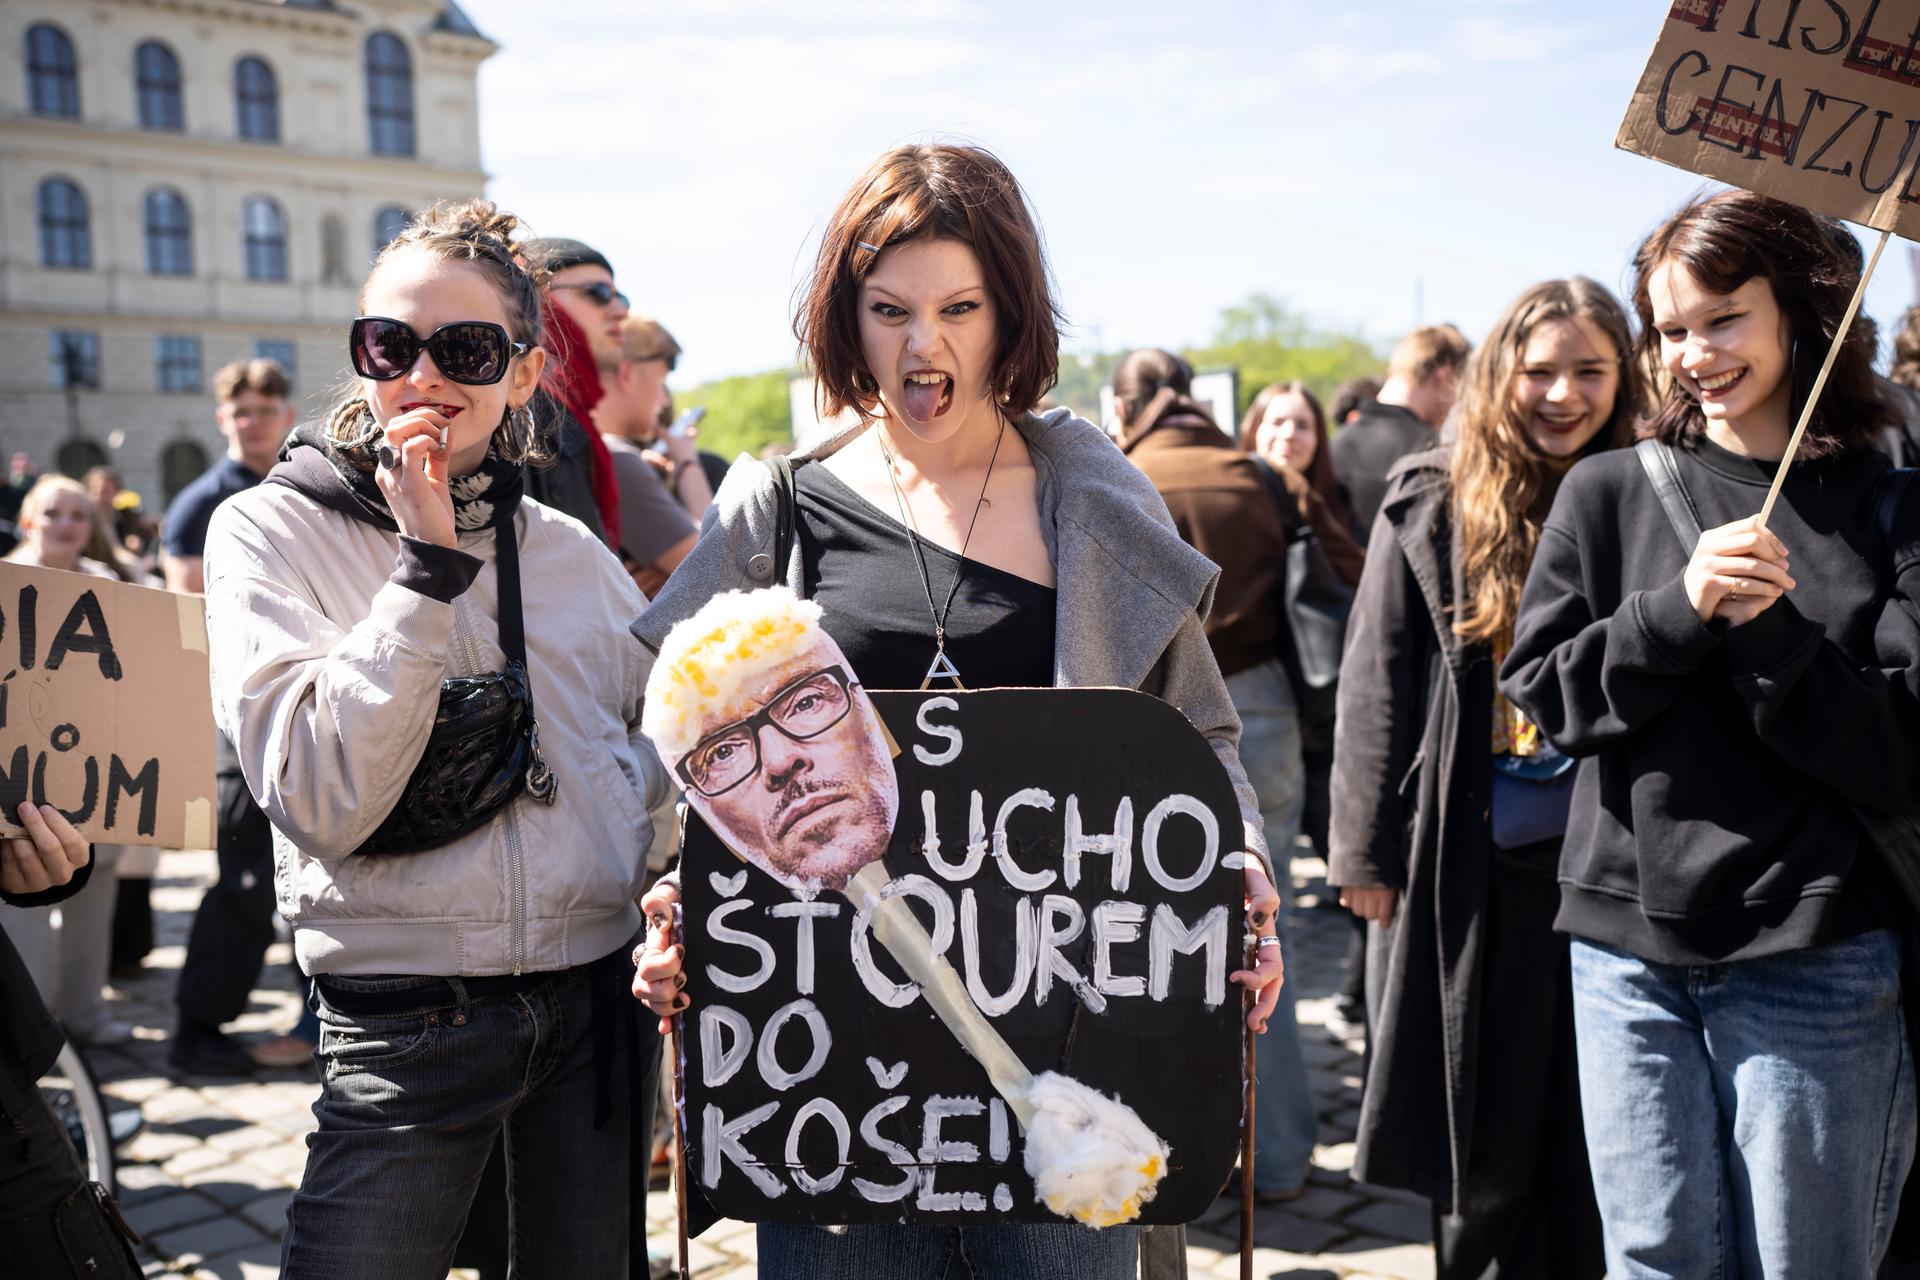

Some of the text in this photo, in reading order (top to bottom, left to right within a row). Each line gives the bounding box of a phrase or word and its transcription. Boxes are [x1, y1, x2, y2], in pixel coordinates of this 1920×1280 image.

[0, 584, 123, 681] IA
[912, 697, 963, 766] S
[921, 787, 1245, 892] UCHO-
[700, 1000, 832, 1090] DO
[702, 1055, 1014, 1211] KOŠE!
